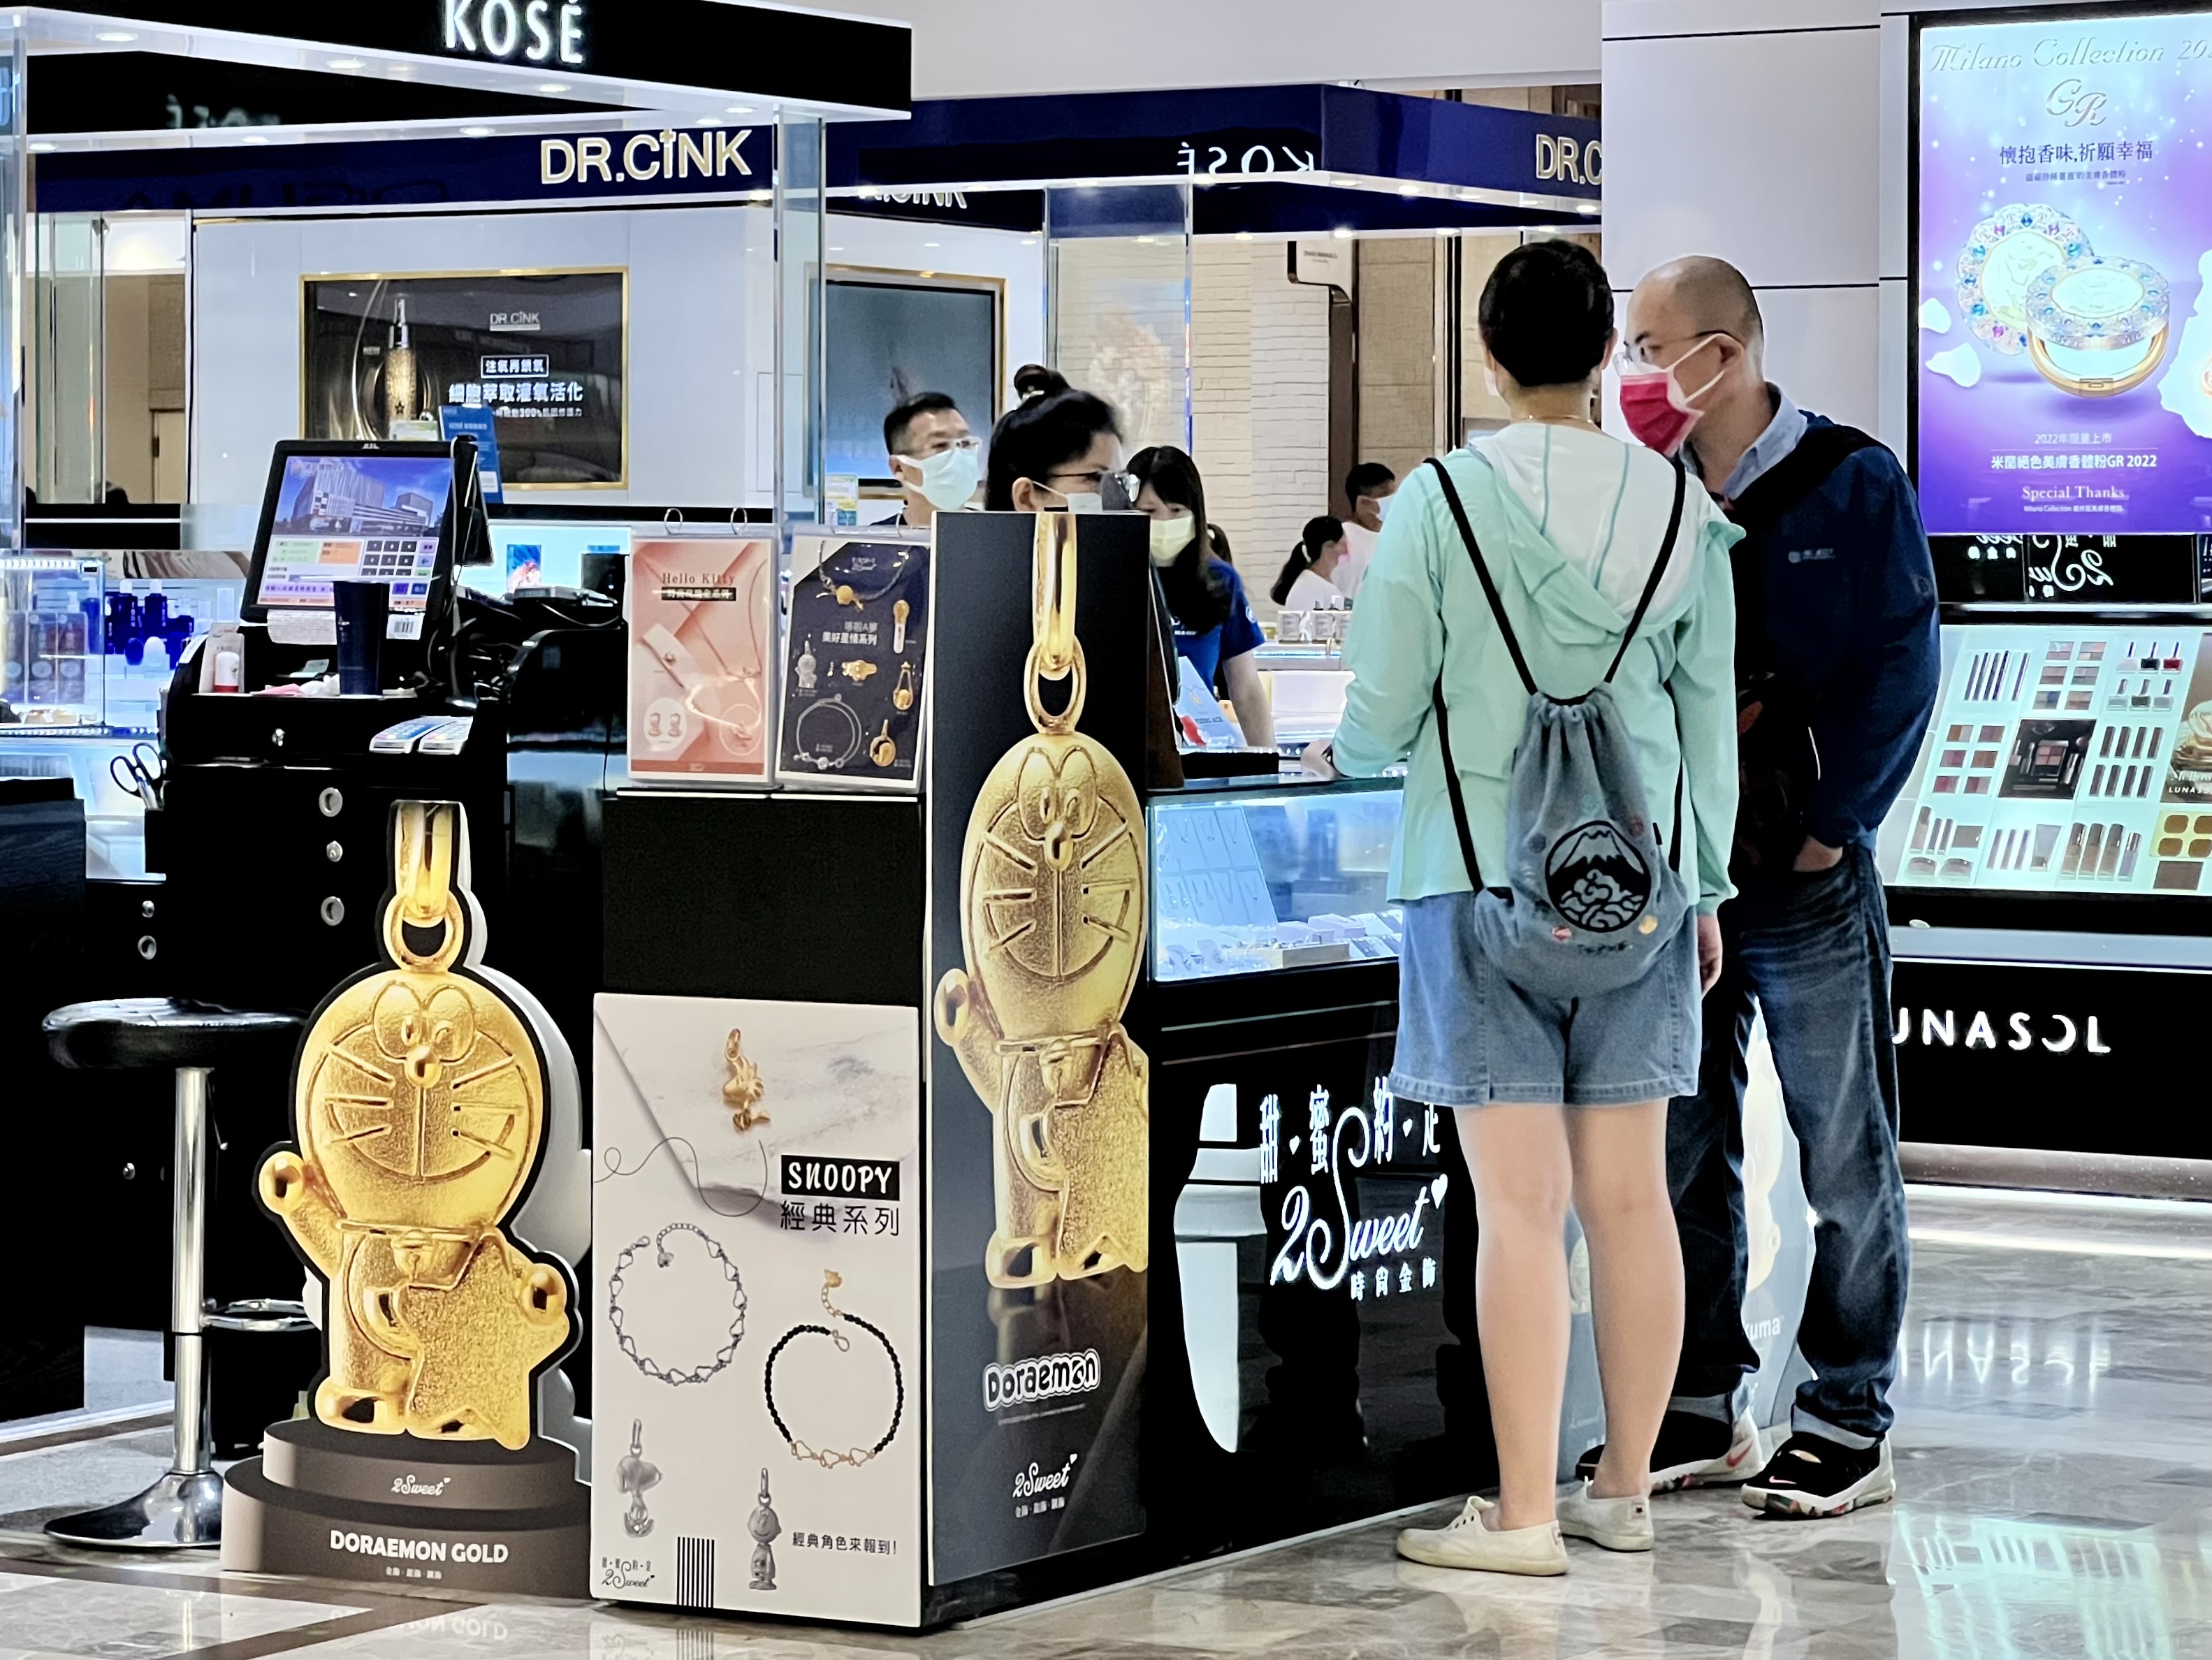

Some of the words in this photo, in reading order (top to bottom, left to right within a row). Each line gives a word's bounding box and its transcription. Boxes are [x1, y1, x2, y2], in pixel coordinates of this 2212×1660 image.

[1930, 43, 2023, 71] Milano
[2034, 37, 2165, 66] Collection
[2127, 454, 2158, 467] 2022
[2022, 486, 2070, 502] Special
[2074, 485, 2125, 499] Thanks
[662, 573, 695, 584] Hello
[702, 573, 735, 586] Kitty
[788, 1162, 892, 1194] SNOOPY
[1269, 1106, 1430, 1290] 2Sweet
[780, 1200, 899, 1237] 經典系列
[984, 1349, 1100, 1411] Doraemon
[391, 1474, 444, 1497] 2Sweet
[1012, 1462, 1071, 1498] 2Sweet
[330, 1529, 446, 1561] DORAEMON
[451, 1543, 509, 1564] GOLD
